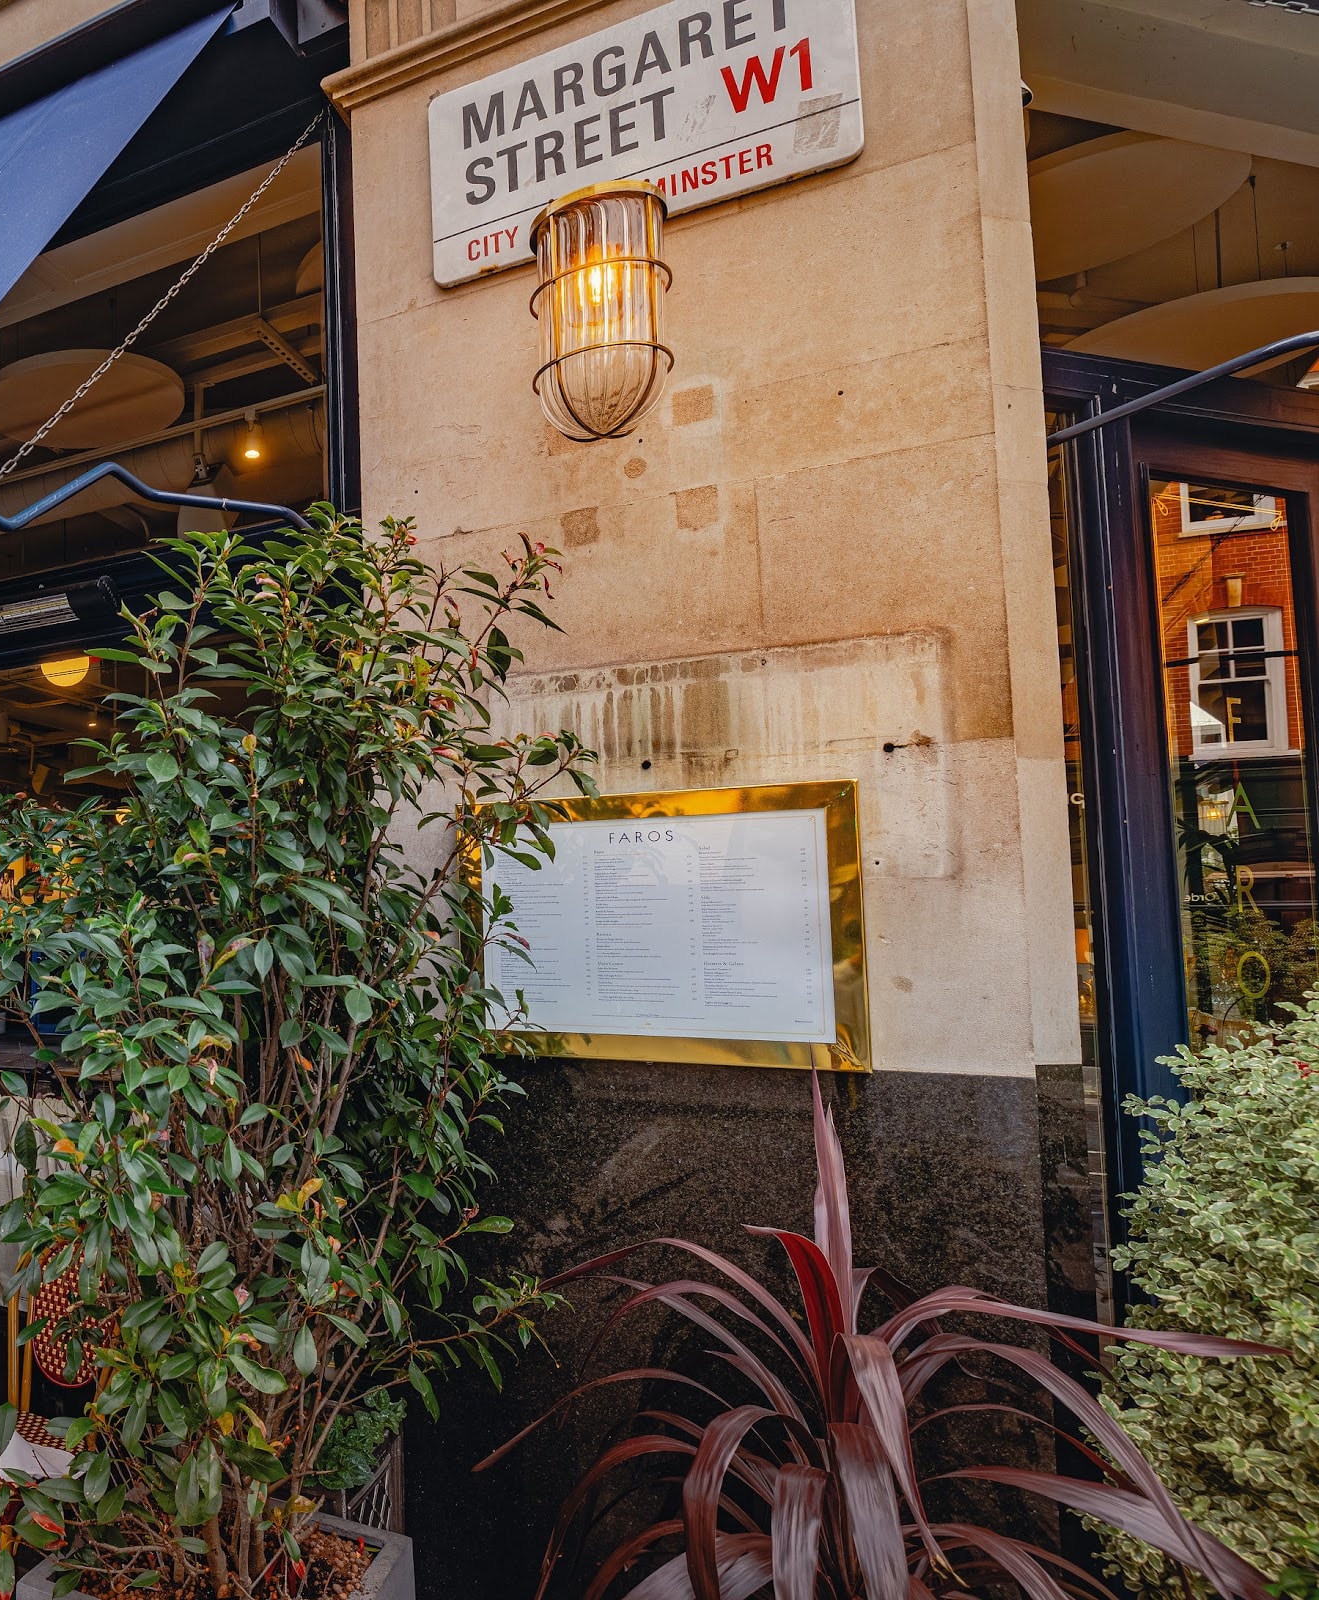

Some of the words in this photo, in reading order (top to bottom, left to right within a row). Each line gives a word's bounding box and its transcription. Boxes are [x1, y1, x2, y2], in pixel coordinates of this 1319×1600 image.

[462, 0, 786, 149] MARGARET
[465, 87, 675, 205] STREET
[720, 37, 814, 114] W1
[467, 225, 519, 262] CITY
[609, 829, 674, 845] FAROS
